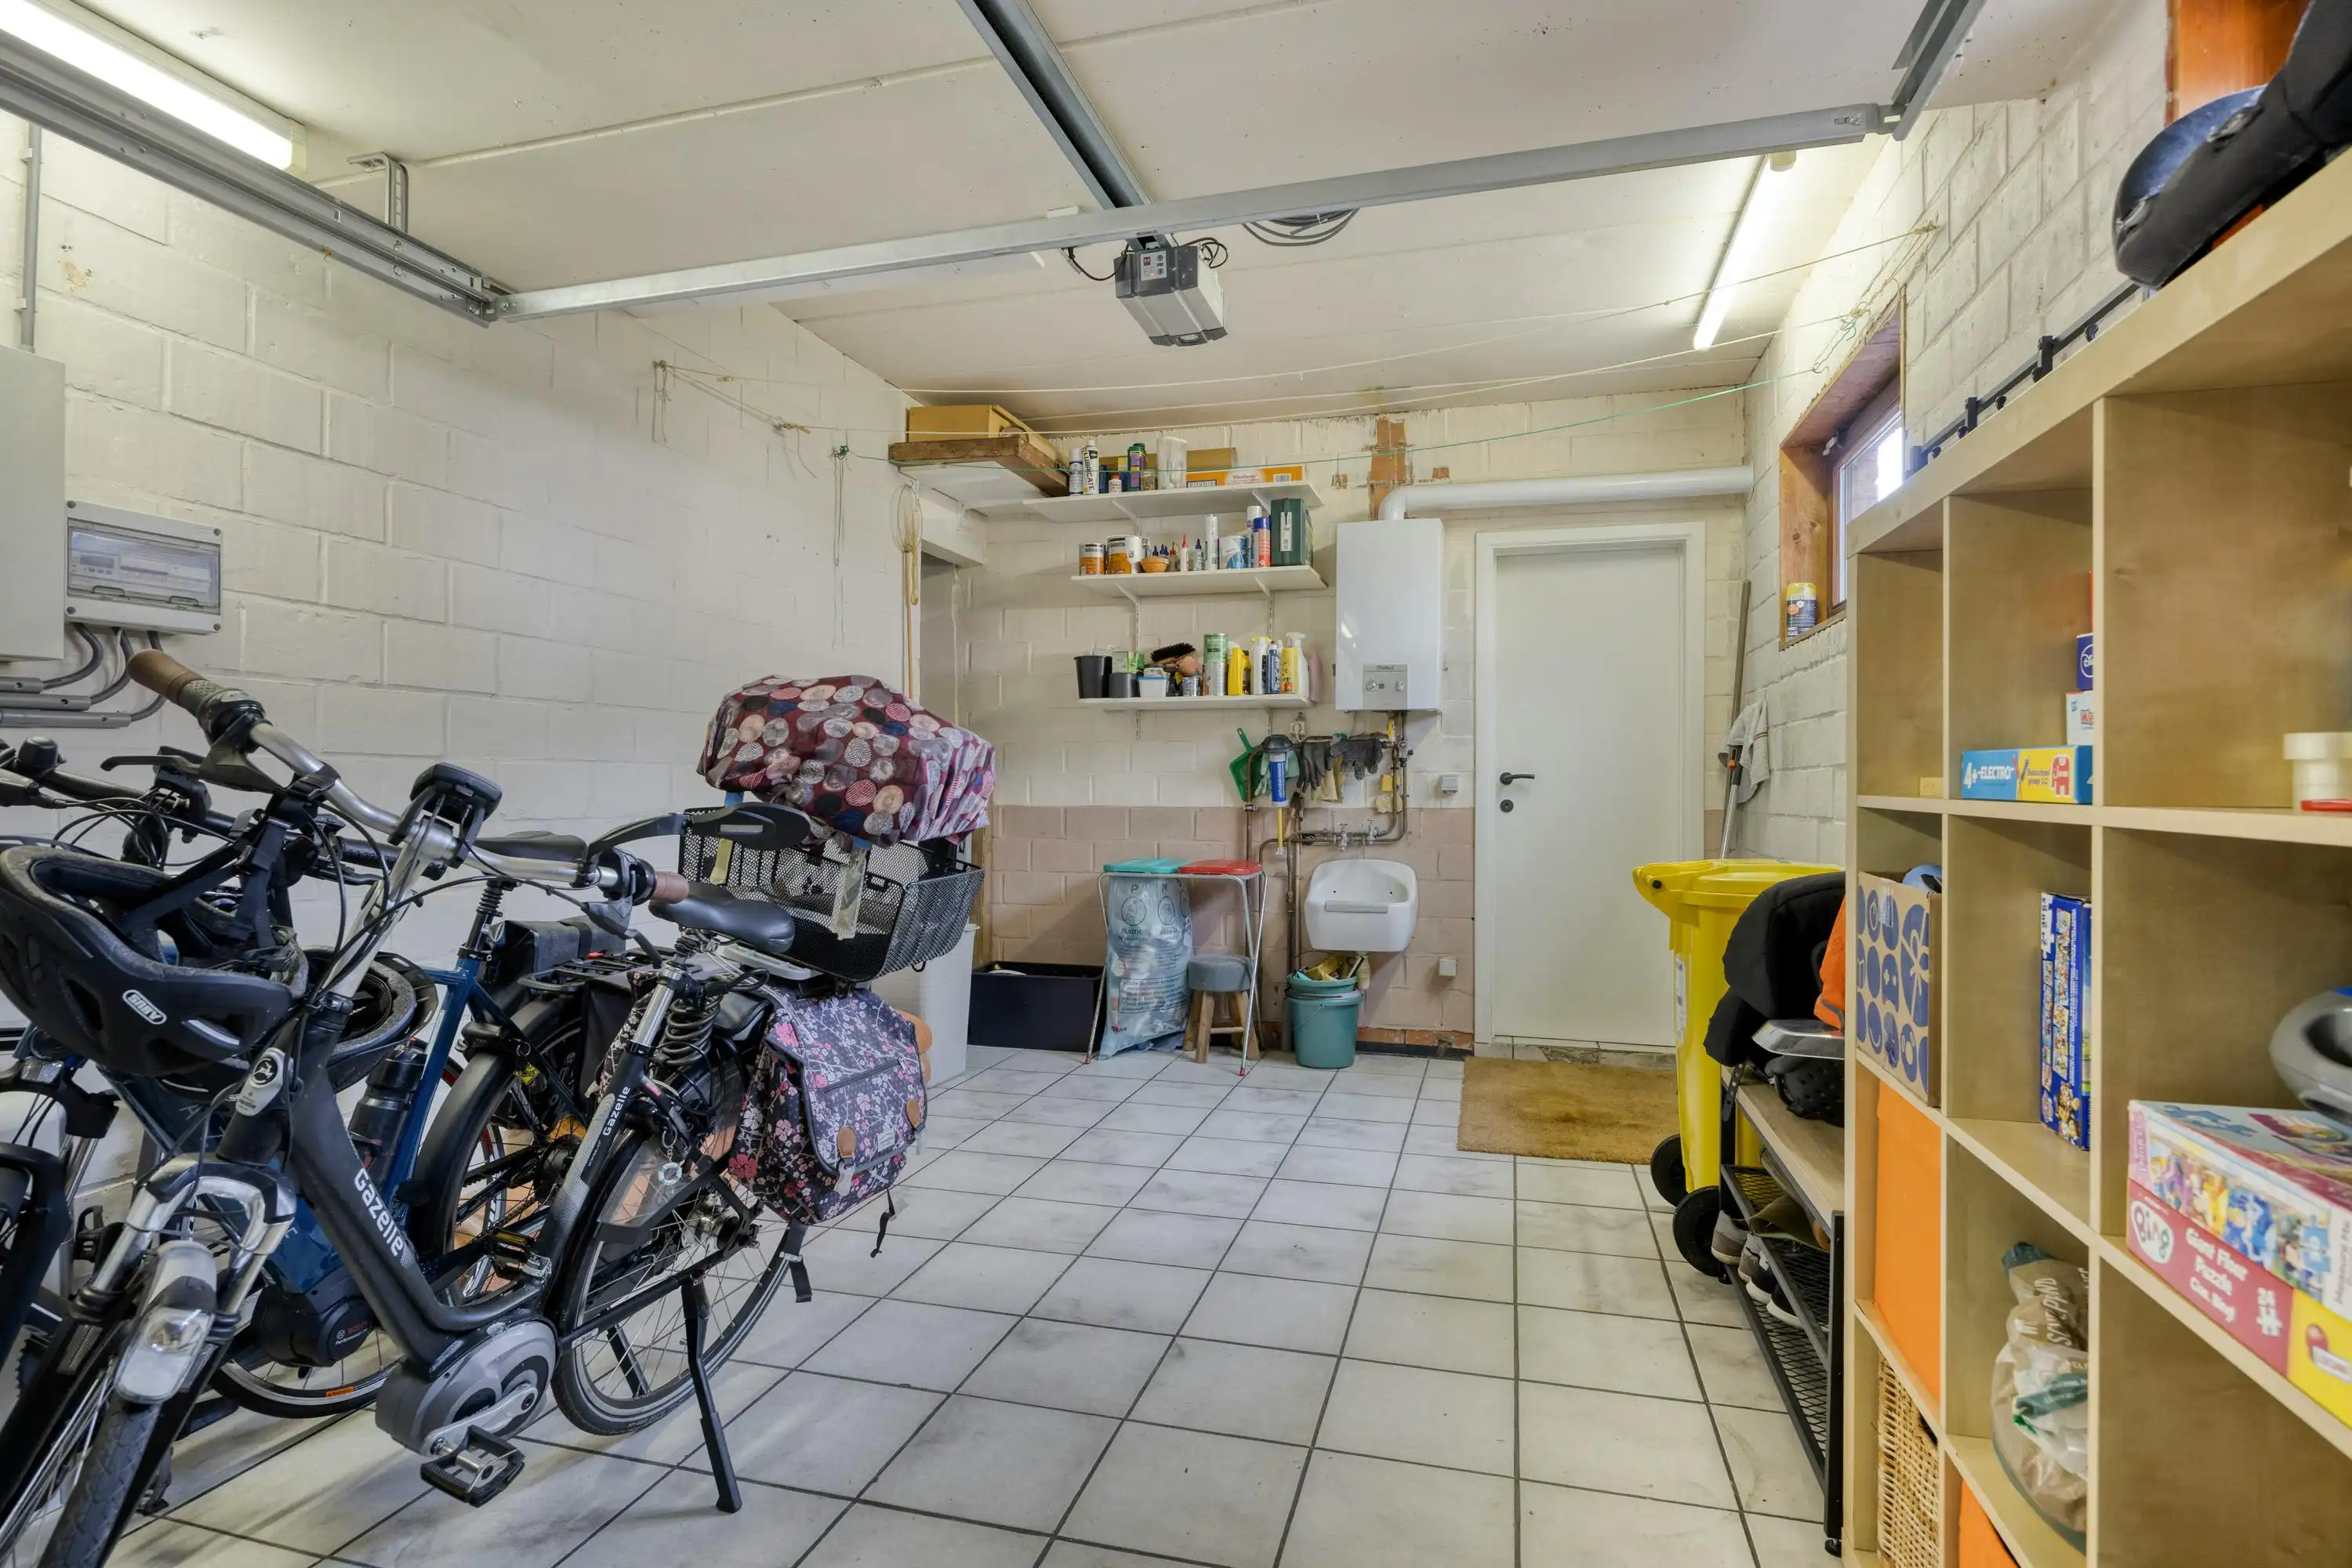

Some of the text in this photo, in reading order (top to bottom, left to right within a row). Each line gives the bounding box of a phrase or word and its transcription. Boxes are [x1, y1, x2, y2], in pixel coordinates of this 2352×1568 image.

[1083, 452, 1095, 491] LUBRICATE
[1980, 765, 2012, 780] ELECTRO
[126, 993, 163, 1021] ABUS
[602, 1086, 631, 1136] Gazelle
[354, 1168, 404, 1257] Gazelle
